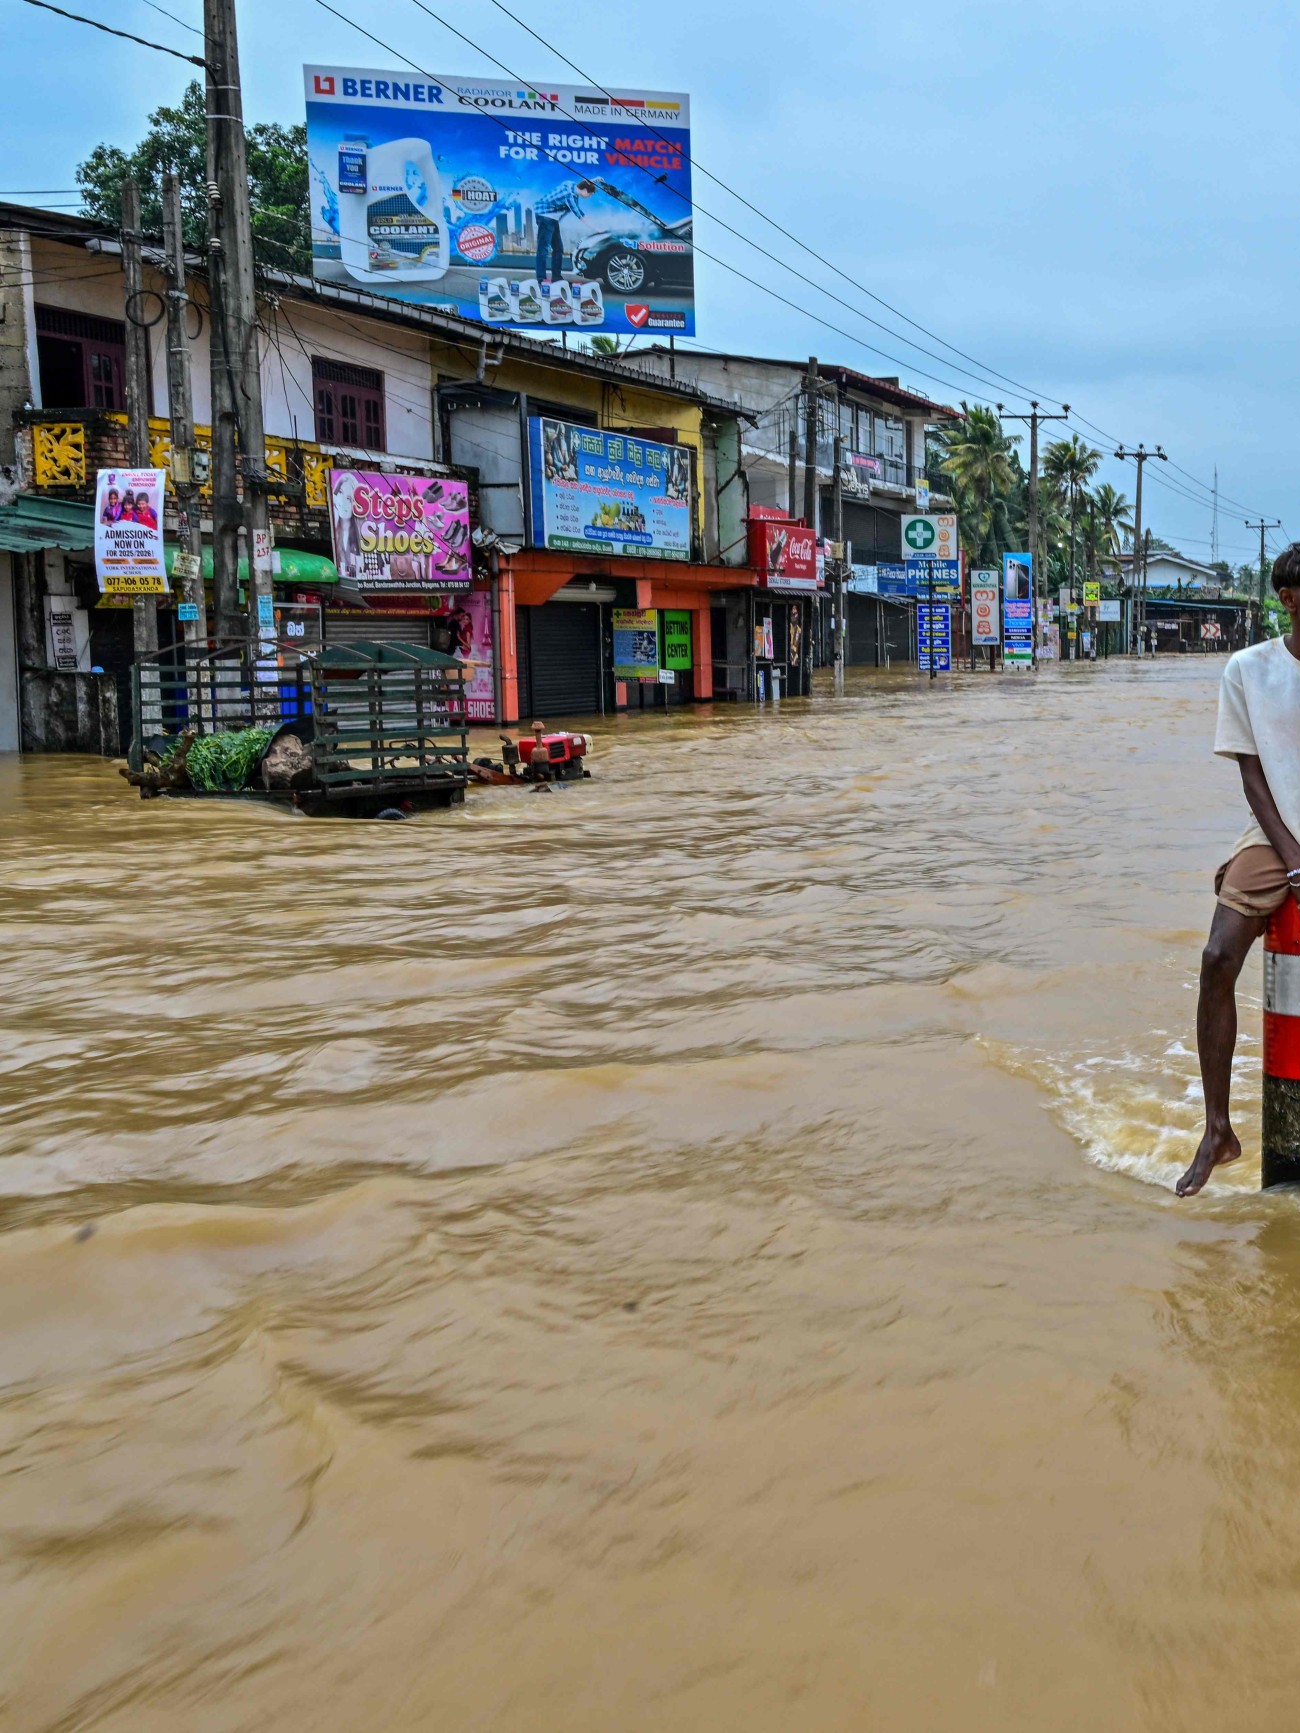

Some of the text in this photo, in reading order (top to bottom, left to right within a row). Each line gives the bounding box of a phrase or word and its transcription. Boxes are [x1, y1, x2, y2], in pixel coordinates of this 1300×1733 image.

[342, 78, 444, 104] BERNER
[457, 87, 512, 98] RADIATOR
[457, 96, 559, 112] COOLANT
[575, 105, 681, 121] MADE IN GERMANY
[505, 130, 682, 155] THE RIGHT MATCH
[499, 146, 682, 170] FOR YOUR VEHICLE
[467, 191, 496, 202] HOAT
[369, 225, 436, 235] COOLANT
[459, 237, 493, 251] ORIGINAL
[639, 241, 685, 252] Solution
[647, 318, 685, 328] Guarantee
[352, 483, 424, 527] Steps
[105, 530, 154, 540] ADMISSIONS
[255, 533, 267, 544] BP
[360, 520, 436, 554] Shoes
[114, 541, 145, 549] NOW ON
[256, 547, 270, 558] 237
[106, 577, 162, 586] 077-106 05 78
[665, 620, 688, 635] BETTING
[667, 643, 688, 658] CENTER
[467, 701, 495, 718] SHOES
